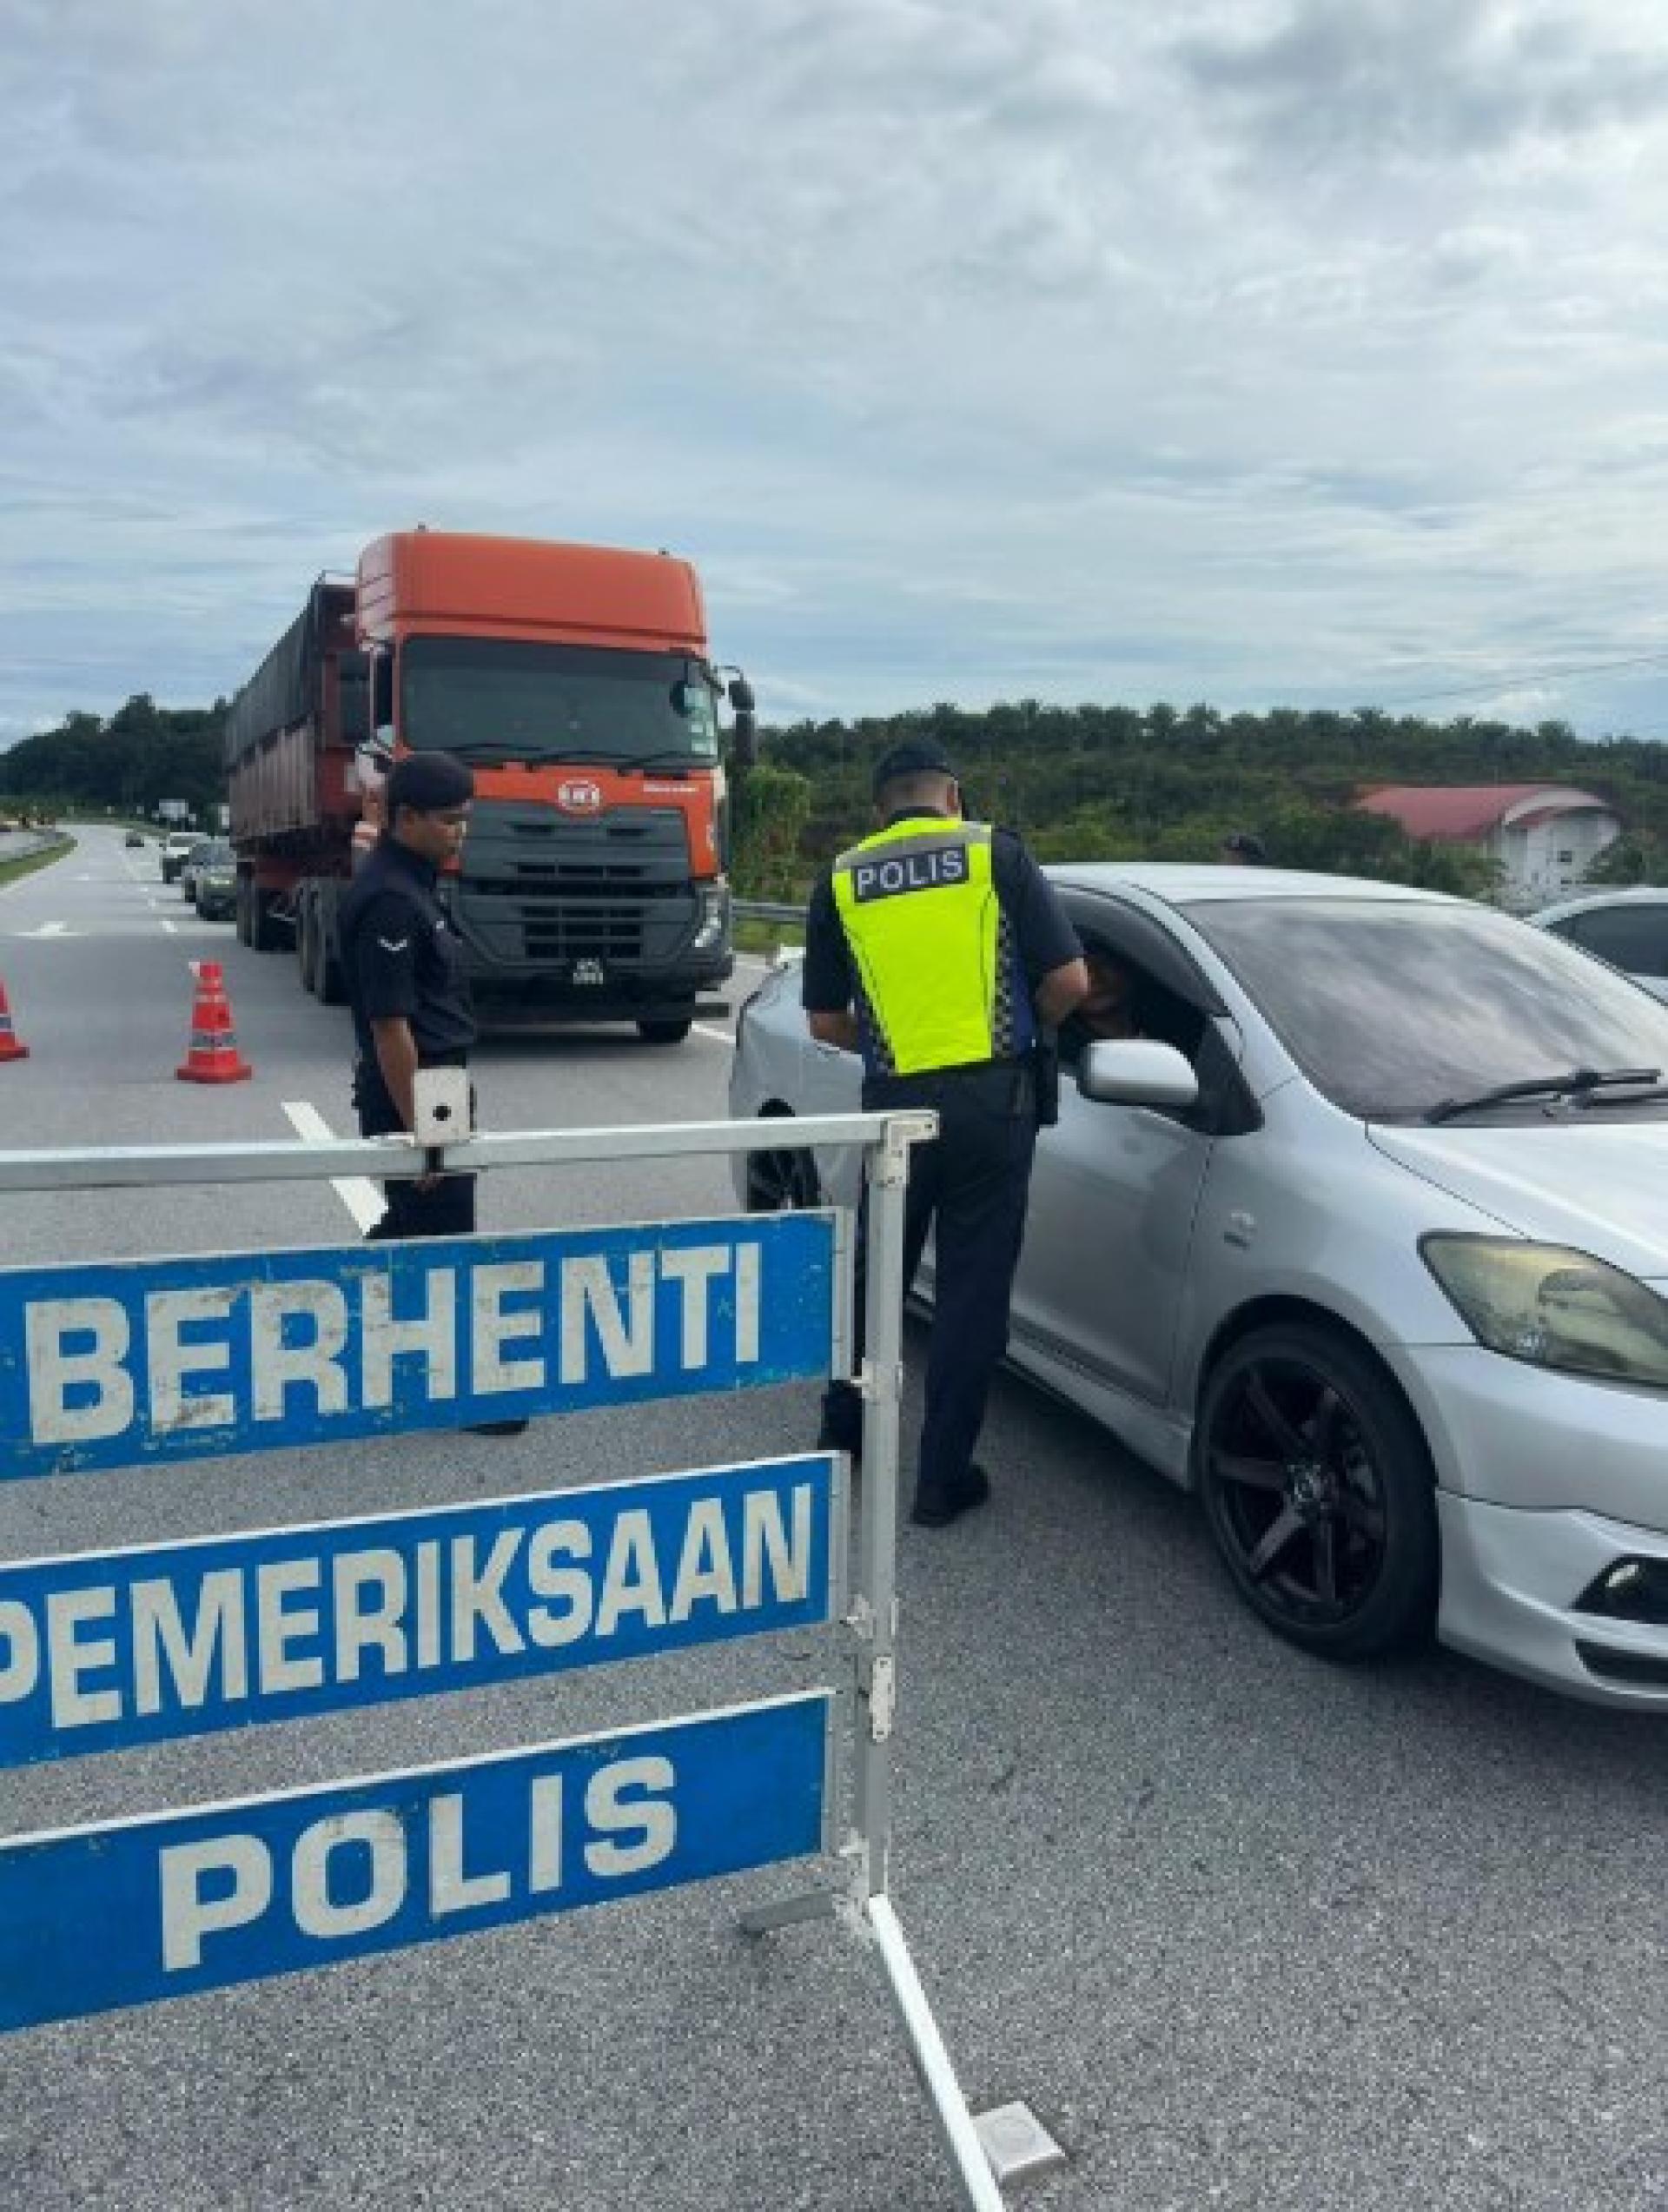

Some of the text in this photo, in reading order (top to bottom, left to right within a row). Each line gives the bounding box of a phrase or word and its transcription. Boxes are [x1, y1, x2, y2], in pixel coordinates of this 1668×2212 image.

[857, 850, 963, 897] POLIS
[25, 1242, 760, 1444] BERHENTI
[160, 1756, 678, 1972] POLIS
